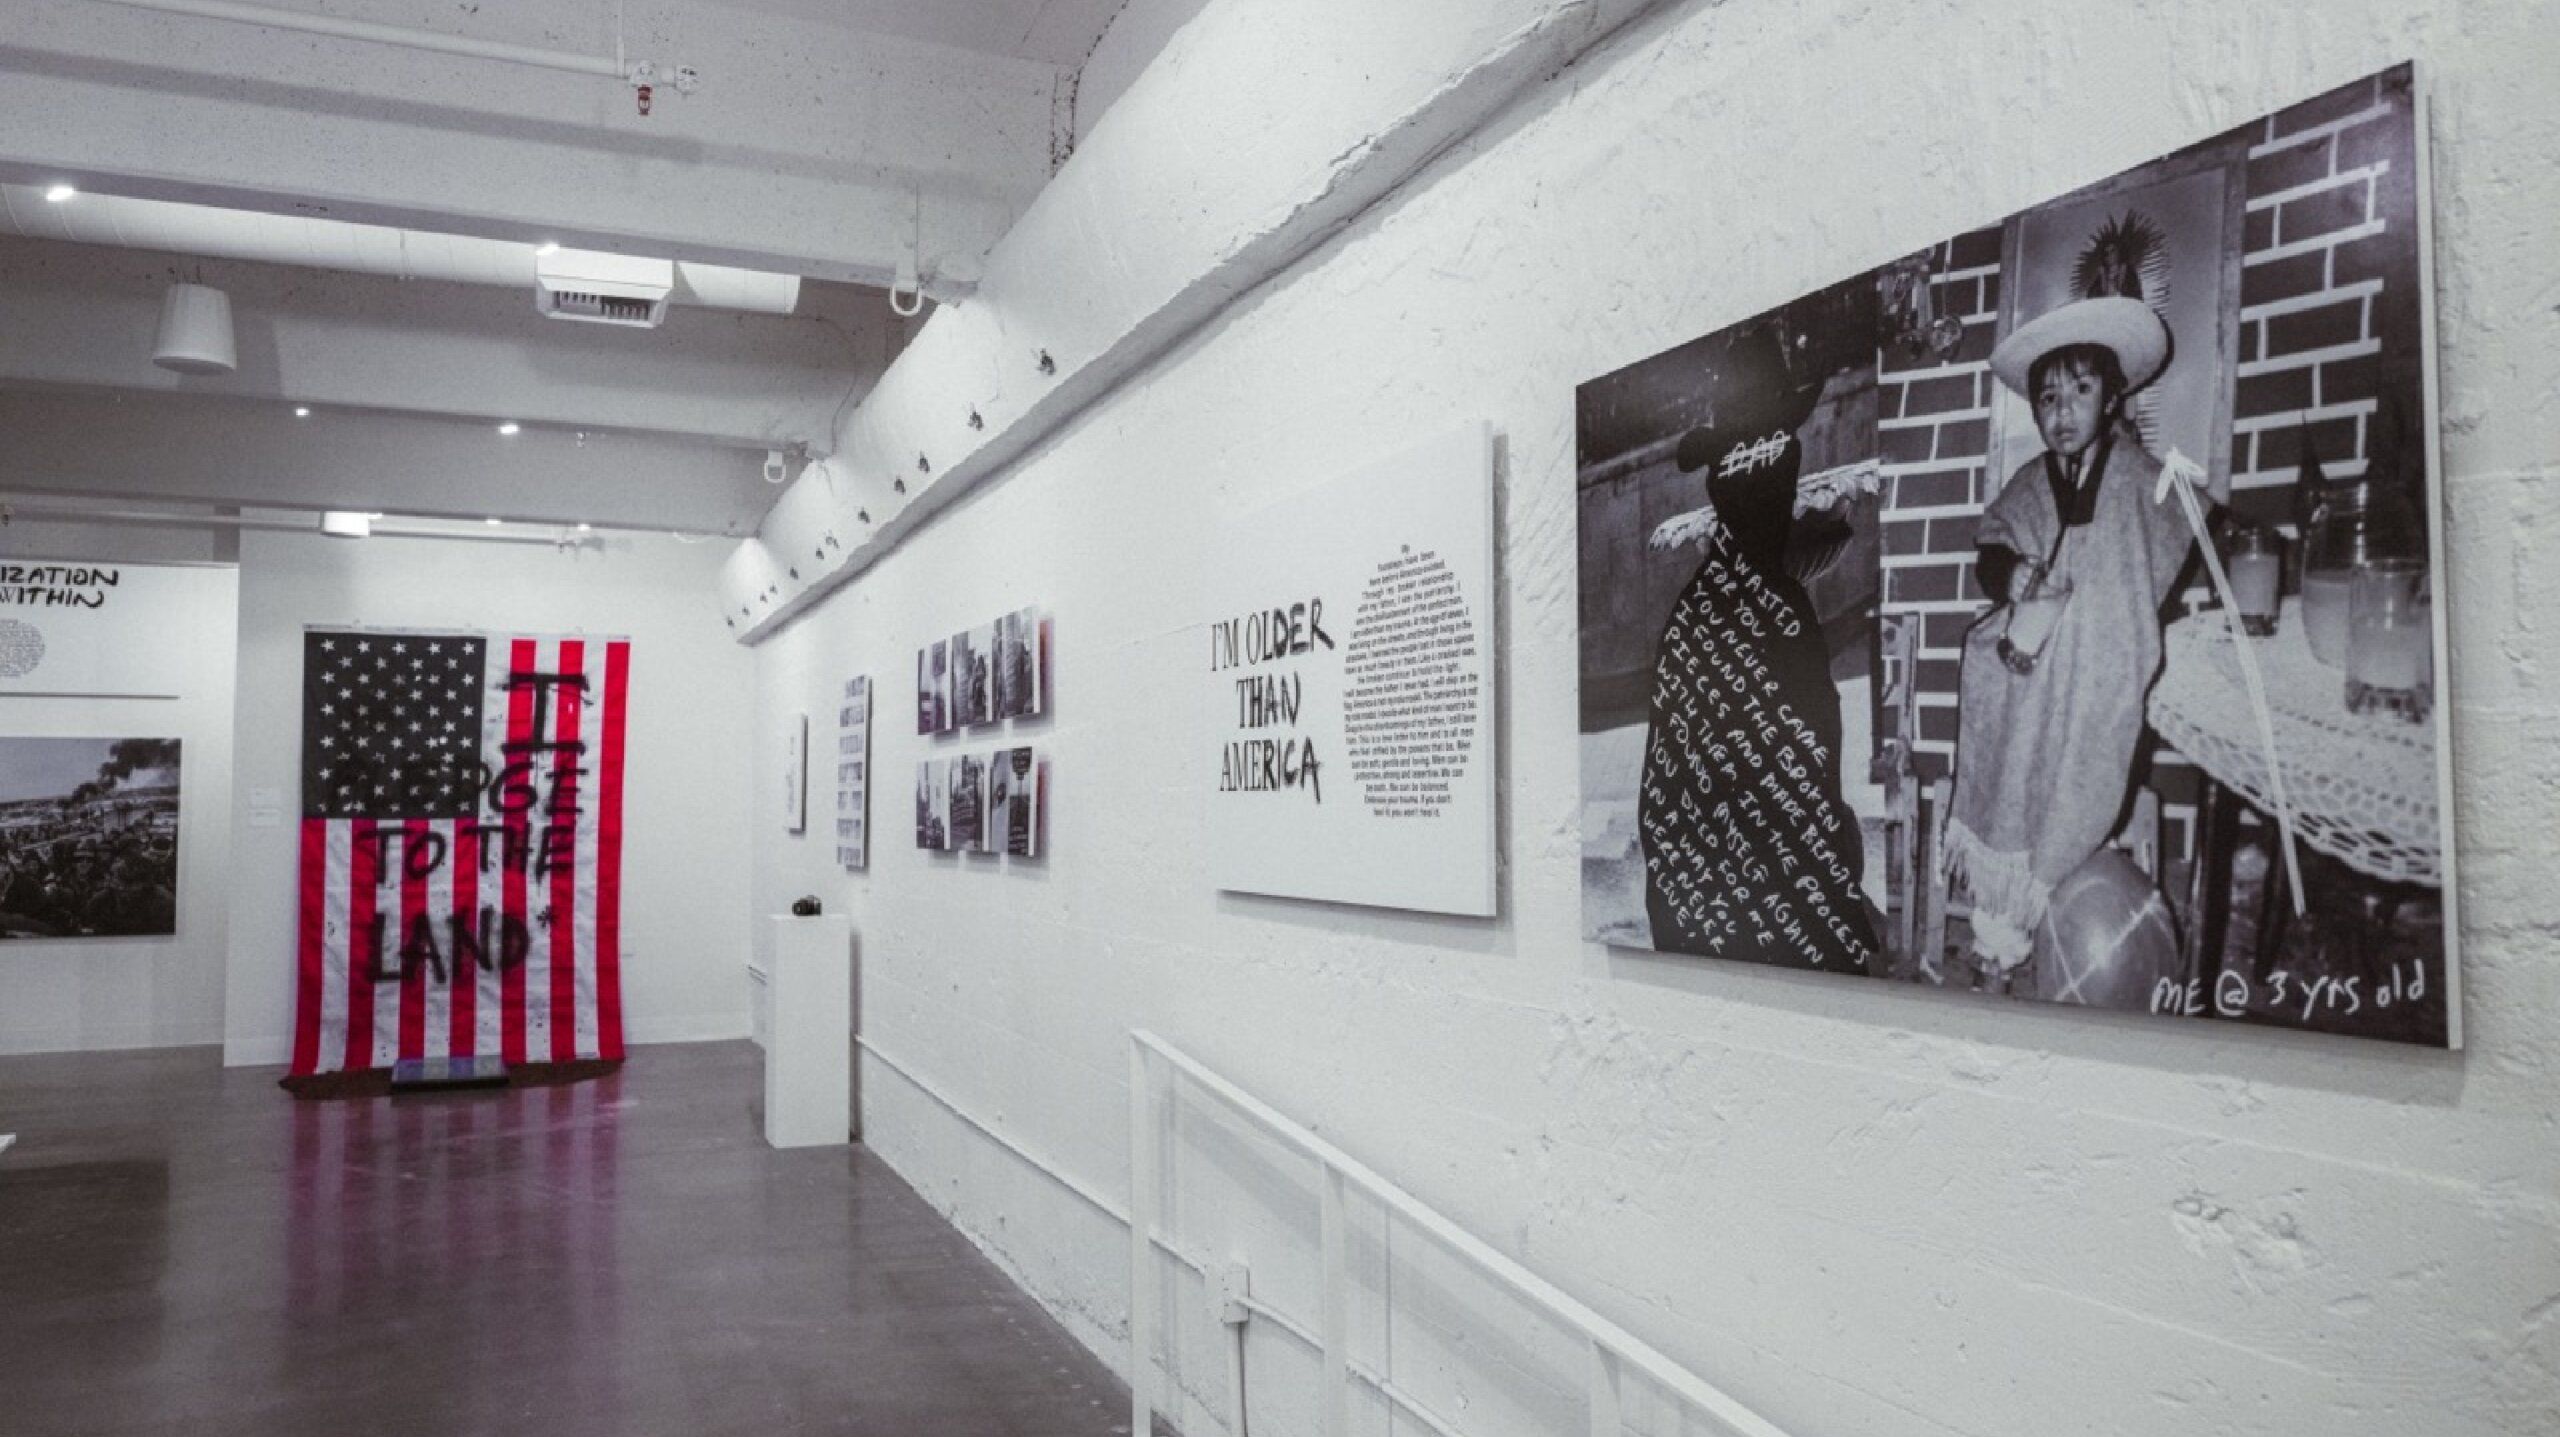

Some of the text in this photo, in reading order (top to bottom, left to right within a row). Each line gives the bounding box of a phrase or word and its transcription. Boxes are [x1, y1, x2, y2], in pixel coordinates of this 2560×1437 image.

[1, 566, 119, 586] IZATION
[1704, 561, 1736, 596] FOR
[1714, 523, 1800, 636] I WAITED
[1211, 617, 1239, 671] I'M
[1246, 597, 1335, 665] OLDER
[1693, 582, 1723, 625] YOU
[1721, 629, 1779, 696] NEVER
[495, 671, 592, 756] I
[1236, 671, 1301, 729] THAN
[1664, 626, 1730, 719] PIECES
[1727, 729, 1762, 768] AND
[1760, 772, 1806, 826] MADE
[1676, 600, 1840, 832] I FOUND THE BROKEN
[1220, 736, 1323, 804] AMERICA
[1652, 681, 1670, 710] I
[1670, 712, 1712, 793] FOUND
[1712, 802, 1769, 883] MYSELF
[1657, 655, 1697, 719] WITH
[1738, 791, 1767, 827] IN
[1768, 829, 1799, 875] THE
[1795, 875, 1870, 964] PROCESS
[359, 820, 576, 886] TO THE
[1643, 768, 1736, 934] IN A WAY YOU
[1652, 726, 1677, 777] YOU
[1718, 859, 1750, 902] FOR
[1749, 910, 1775, 946] ME
[1677, 871, 1725, 953] NEVER
[2151, 958, 2425, 1021] ME @ 3 yrs old
